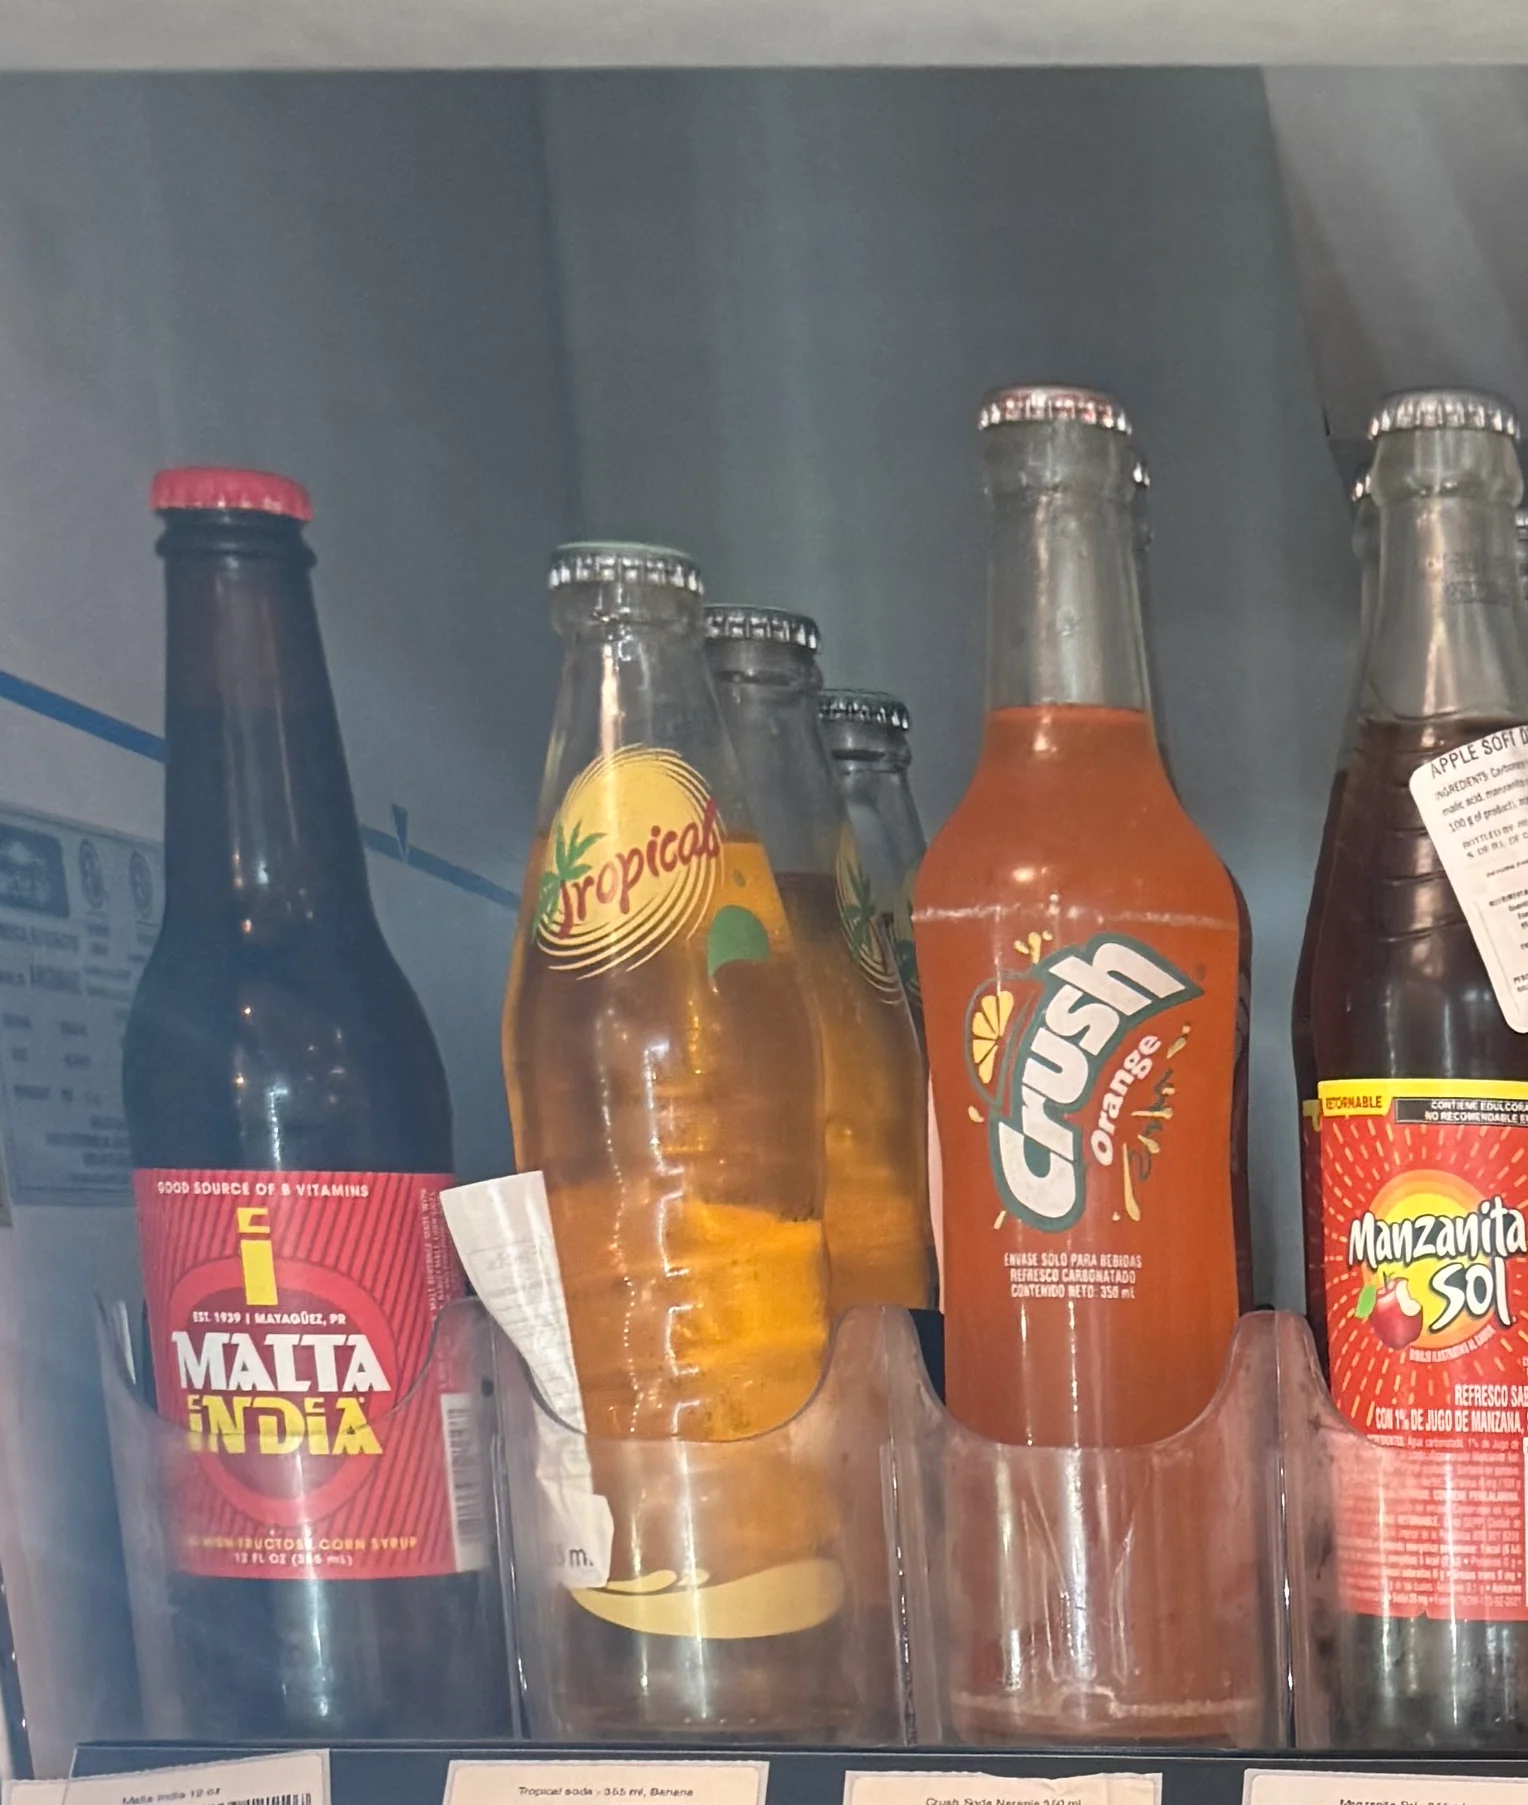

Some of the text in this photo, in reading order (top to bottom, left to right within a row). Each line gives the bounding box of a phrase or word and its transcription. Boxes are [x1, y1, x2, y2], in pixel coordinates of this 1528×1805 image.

[1430, 743, 1477, 780] APPLE
[559, 800, 719, 940] Tropical
[998, 942, 1186, 1219] Crush
[1090, 1034, 1161, 1166] Orange
[1431, 1100, 1479, 1112] CONTIENE
[193, 1181, 369, 1198] SOURCE OF VITAMINS
[1348, 1196, 1528, 1268] Manzanita
[1100, 1253, 1142, 1269] BEBIDAS
[1010, 1268, 1136, 1284] REFRESCO CARBONATADO
[1429, 1257, 1513, 1333] Sol
[330, 1312, 346, 1325] PR
[172, 1331, 391, 1393] MALTA
[1454, 1384, 1508, 1408] REFRESCO
[1375, 1409, 1394, 1430] CON
[1411, 1410, 1425, 1431] DE
[1426, 1410, 1452, 1432] JUGO
[1455, 1411, 1469, 1432] DE
[1471, 1411, 1525, 1434] MANZANA,
[371, 1537, 418, 1551] SYRUP
[518, 1786, 563, 1798] Tropical
